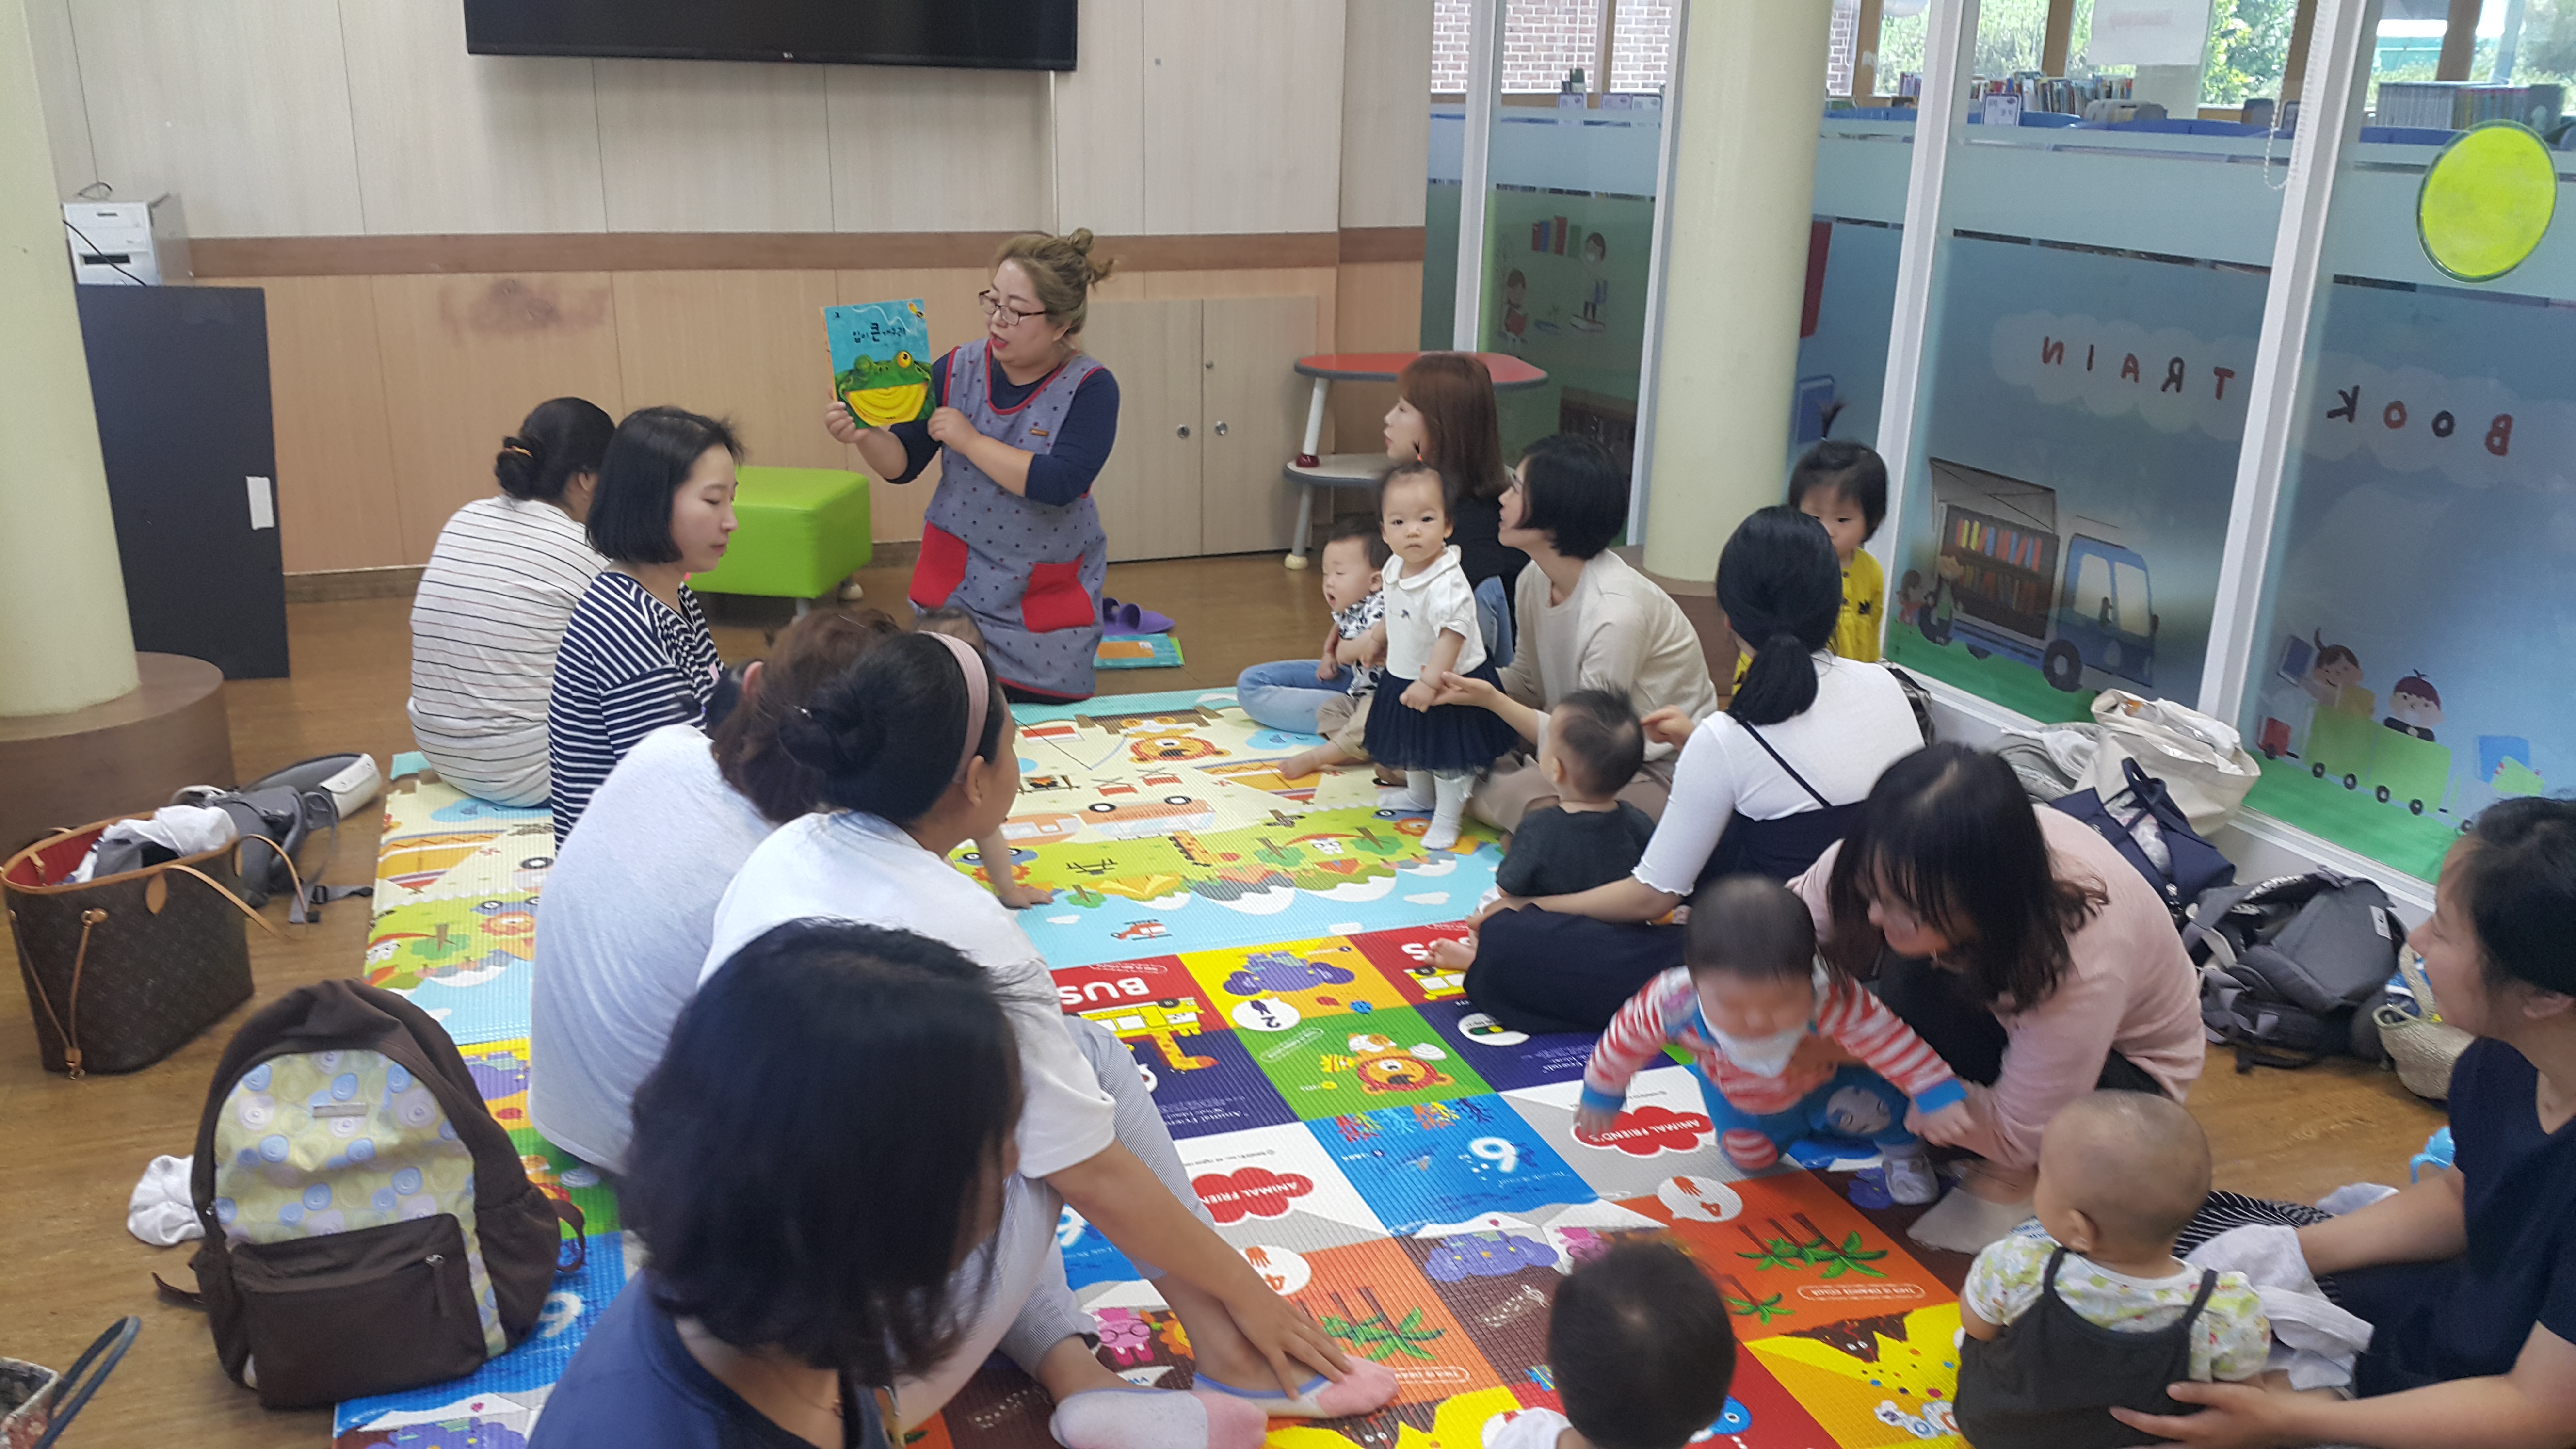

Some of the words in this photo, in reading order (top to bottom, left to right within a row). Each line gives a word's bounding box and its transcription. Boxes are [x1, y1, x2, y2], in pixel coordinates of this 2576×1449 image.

[870, 322, 880, 342] 큰
[1058, 977, 1151, 1005] BUS
[1648, 1119, 1700, 1134] ANIMAL
[1240, 1181, 1298, 1198] ANIMAL
